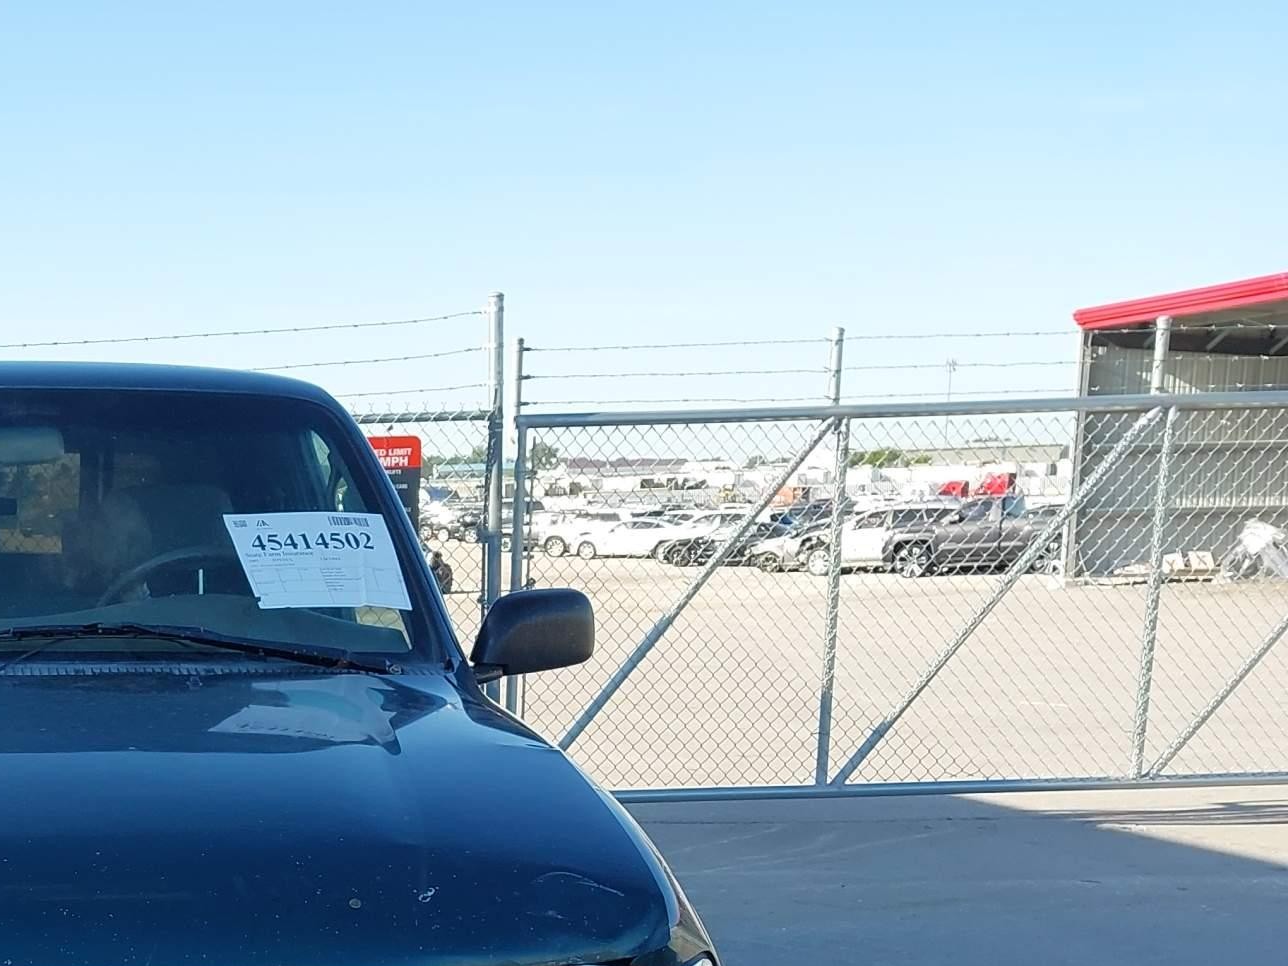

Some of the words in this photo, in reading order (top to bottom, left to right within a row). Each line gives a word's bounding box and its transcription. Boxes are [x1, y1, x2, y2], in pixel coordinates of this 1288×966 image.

[388, 447, 412, 455] LIMIT
[380, 456, 409, 467] MPH
[252, 532, 374, 551] 45414502
